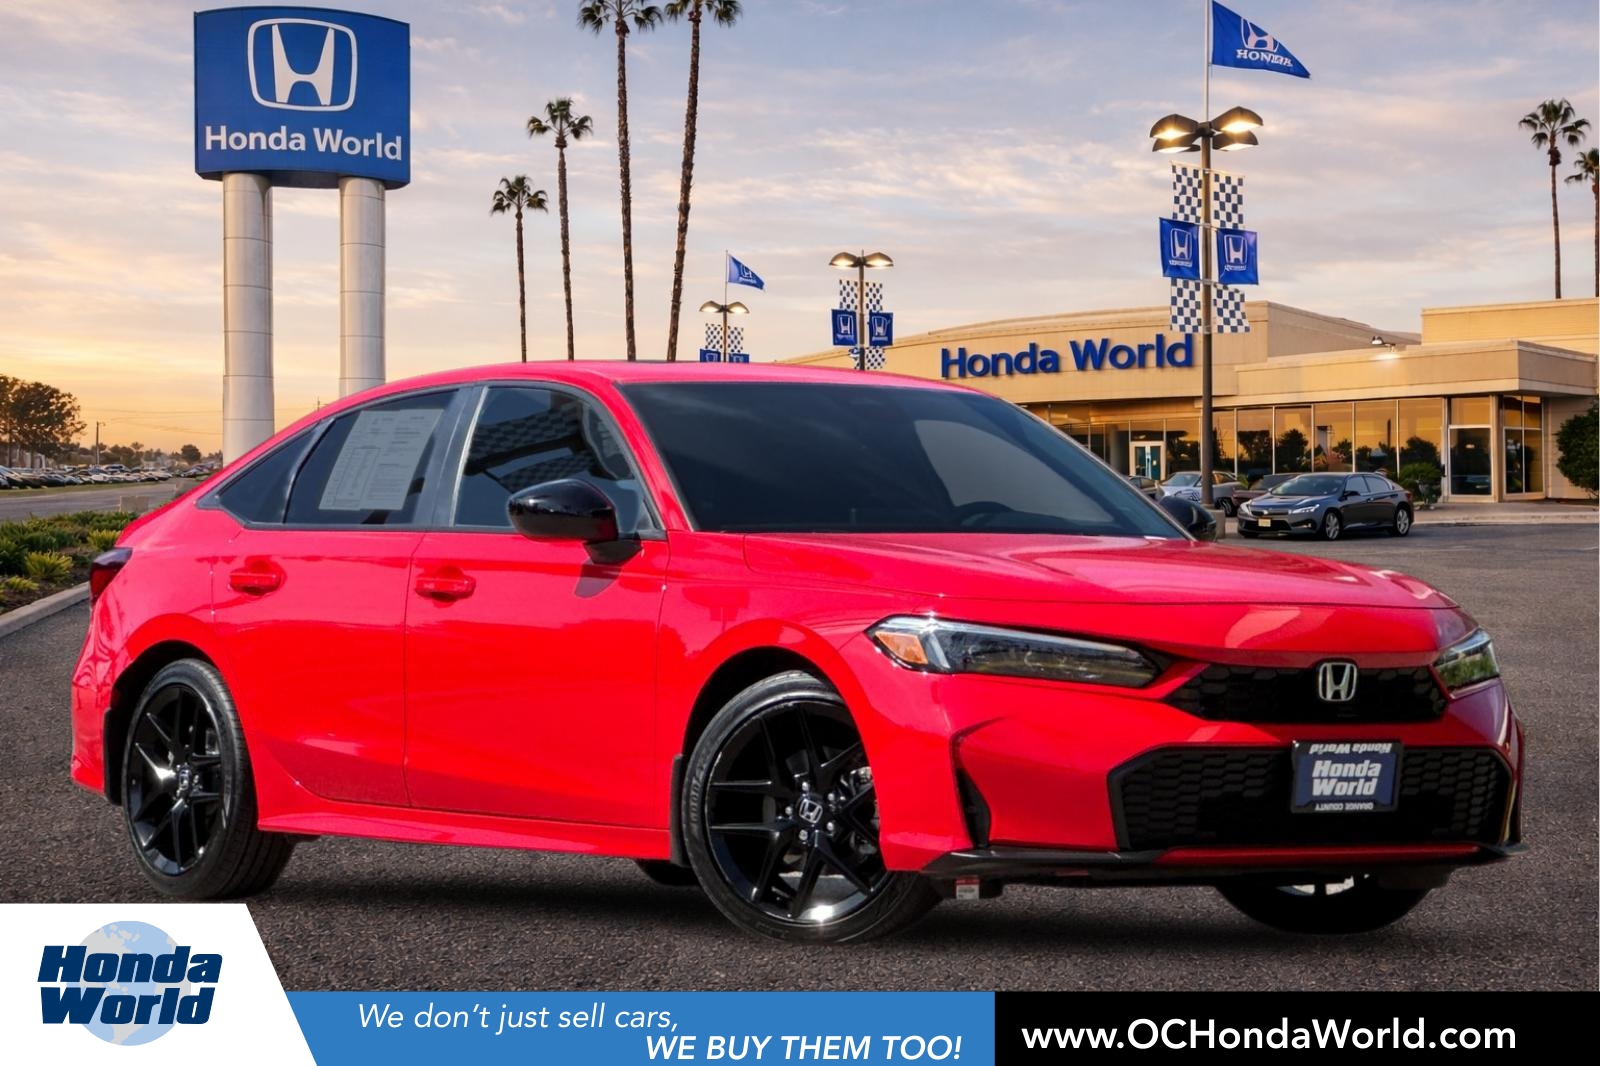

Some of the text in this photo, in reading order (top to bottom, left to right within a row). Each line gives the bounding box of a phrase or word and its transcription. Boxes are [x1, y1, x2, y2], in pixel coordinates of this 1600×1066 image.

[205, 126, 402, 160] Honda World
[941, 333, 1194, 378] Honda World
[1312, 760, 1382, 777] Honda
[1312, 778, 1378, 796] World
